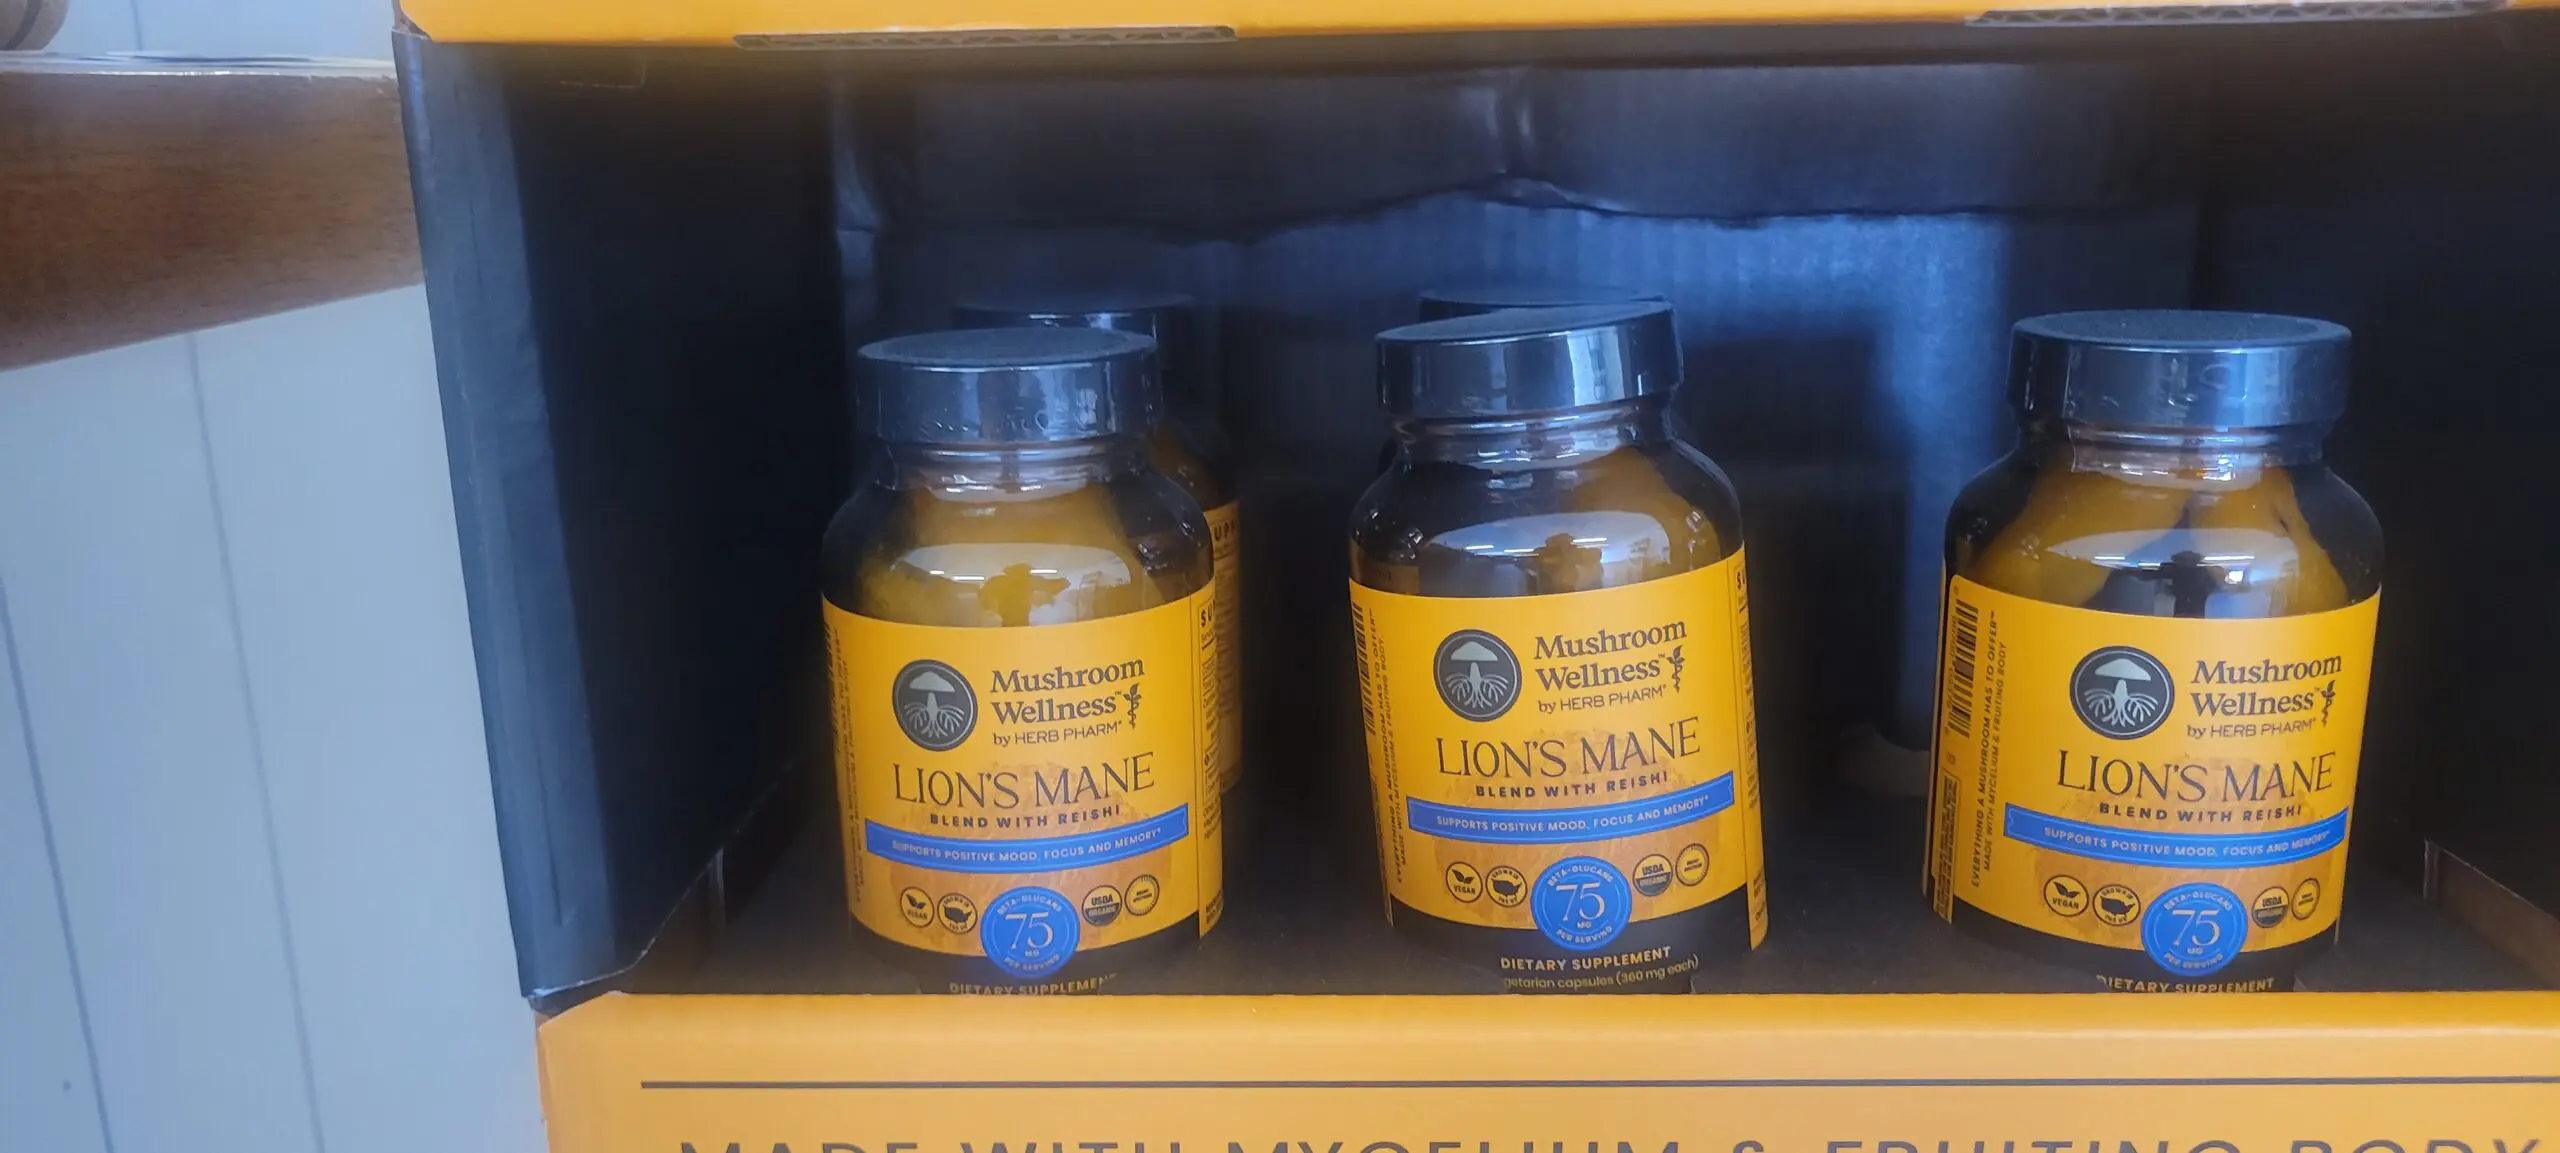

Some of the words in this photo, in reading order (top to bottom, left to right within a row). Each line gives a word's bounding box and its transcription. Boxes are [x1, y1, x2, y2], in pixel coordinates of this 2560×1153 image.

[1533, 621, 1688, 660] Mushroom
[1997, 641, 2006, 676] BODY
[2191, 655, 2342, 684] Mushroom
[990, 659, 1145, 693] Mushroom
[1986, 665, 1995, 682] TO
[1538, 700, 1556, 714] by
[1560, 695, 1605, 711] HERB
[1984, 687, 1993, 714] HAS
[1993, 678, 2004, 731] FRUITING
[993, 733, 1011, 747] by
[1015, 730, 1060, 744] HERB
[2187, 724, 2206, 739] by
[2210, 724, 2257, 737] HERB
[1436, 737, 1567, 779] LION'S
[1581, 716, 1701, 775] MANE
[1978, 717, 1990, 794] MUSHROOM
[893, 763, 1020, 809] LION'S
[1034, 751, 1155, 807] MANE
[1476, 785, 1536, 798] BLEND
[1544, 783, 1597, 798] WITH
[1606, 770, 1668, 793] REISHI
[1988, 745, 1999, 805] MYCELIUM
[2057, 749, 2208, 802] LION'S
[2223, 751, 2336, 802] MANE
[930, 813, 989, 829] BLEND
[996, 816, 1048, 829] WITH
[1058, 804, 1120, 825] REISHI
[1436, 815, 1489, 832] SUPPORTS
[1491, 821, 1544, 833] POSITIVE
[1593, 815, 1633, 829] FOCUS
[1637, 808, 1661, 822] AND
[1986, 808, 1995, 835] WITH
[2100, 803, 2168, 820] BLEND
[2178, 810, 2232, 822] WITH
[2243, 804, 2302, 821] REISHI
[891, 840, 942, 858] SUPPORTS
[944, 851, 995, 862] POSITIVE
[1044, 846, 1084, 860] FOCUS
[1088, 842, 1112, 854] AND
[1971, 810, 1984, 888] EVERYTHING
[2044, 826, 2107, 848] SUPPORTS
[2111, 840, 2169, 856] POSITIVE
[2223, 844, 2264, 856] FOCUS
[2266, 842, 2289, 853] AND
[1641, 863, 1665, 876] USDA
[1984, 840, 1992, 871] MADE
[1091, 894, 1114, 906] USDA
[1453, 884, 1476, 895] VEGAN
[1556, 882, 1605, 921] 75
[2052, 897, 2080, 910] VEGAN
[1005, 911, 1054, 949] 75
[2172, 909, 2219, 946] 75
[1500, 957, 1567, 971] DIETARY
[1572, 946, 1671, 970] SUPPLEMENT
[1503, 976, 1555, 989] getarian
[1557, 976, 1614, 991] capsules
[1616, 970, 1643, 986] (360
[1645, 966, 1665, 980] mg
[1667, 953, 1699, 975] each)
[949, 982, 1013, 995] DIETARY
[2174, 977, 2275, 993] SUPPLEMENT
